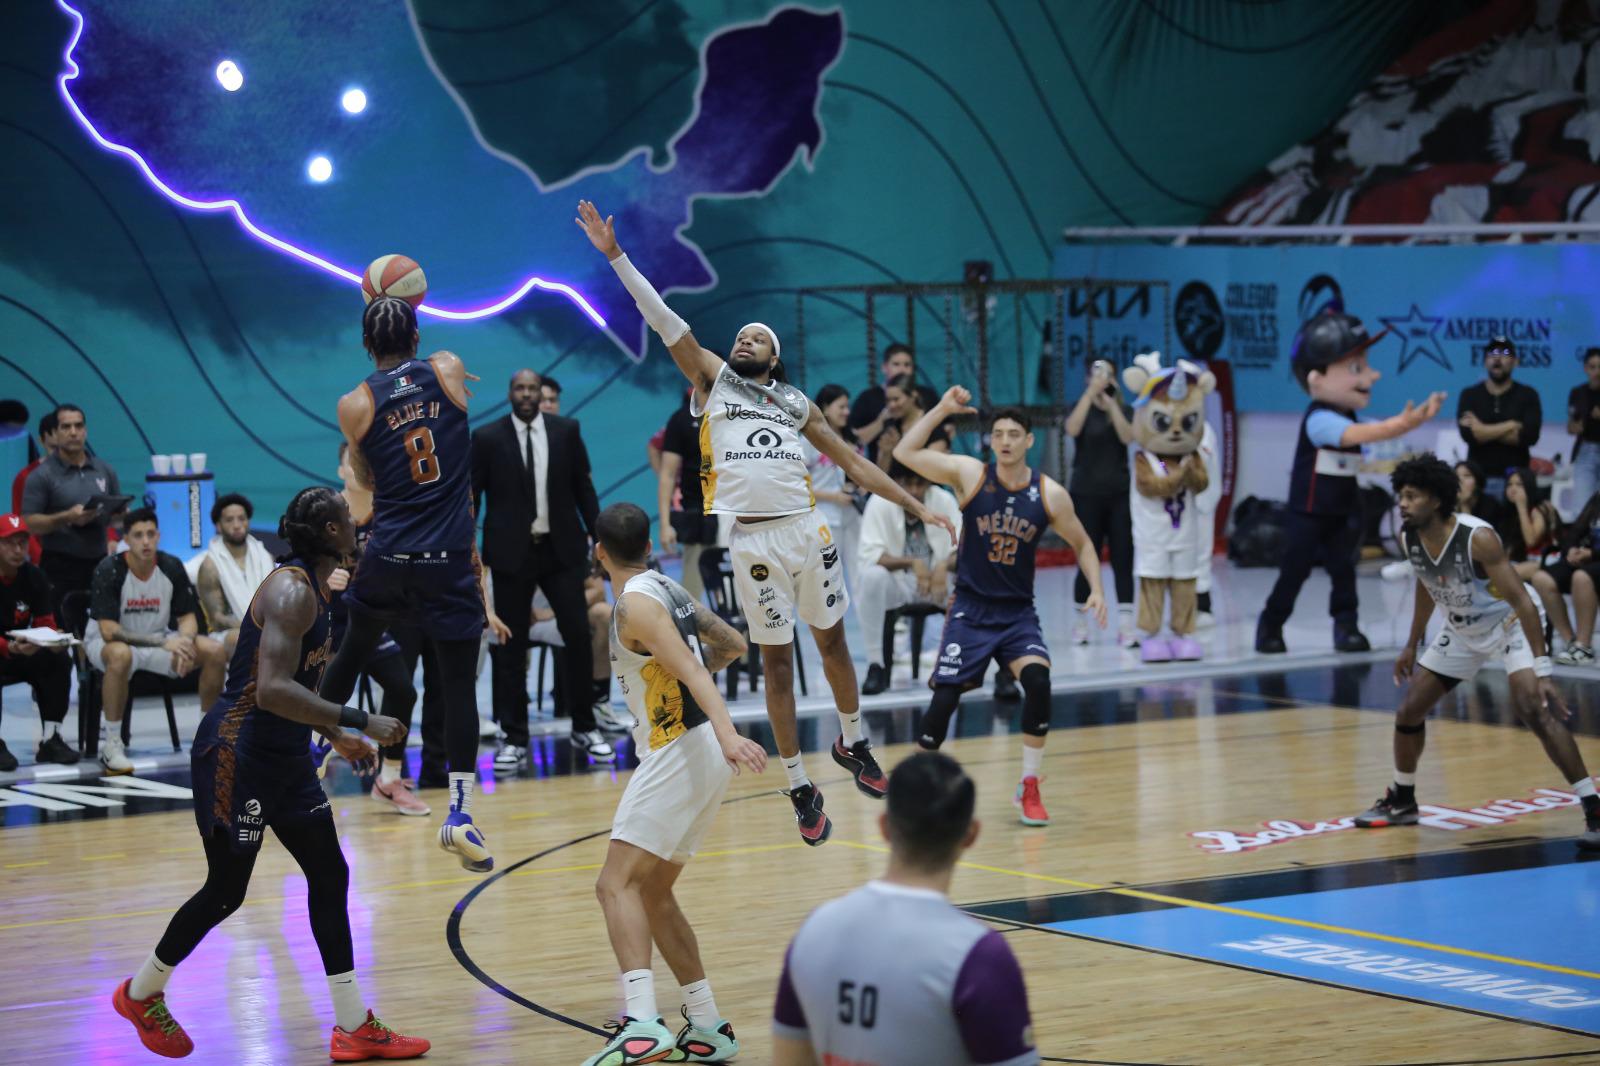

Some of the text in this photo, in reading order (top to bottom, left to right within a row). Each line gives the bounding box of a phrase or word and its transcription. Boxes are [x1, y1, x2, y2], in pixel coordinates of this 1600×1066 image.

[1069, 284, 1150, 318] KIA
[1445, 318, 1552, 341] AMERICAN
[387, 402, 424, 431] BLUE
[404, 426, 442, 485] 8
[725, 448, 801, 461] Banco Azteca
[977, 510, 1037, 544] MÉXICO
[987, 533, 1019, 565] 32
[765, 618, 789, 630] MEGA
[838, 982, 878, 1029] 50
